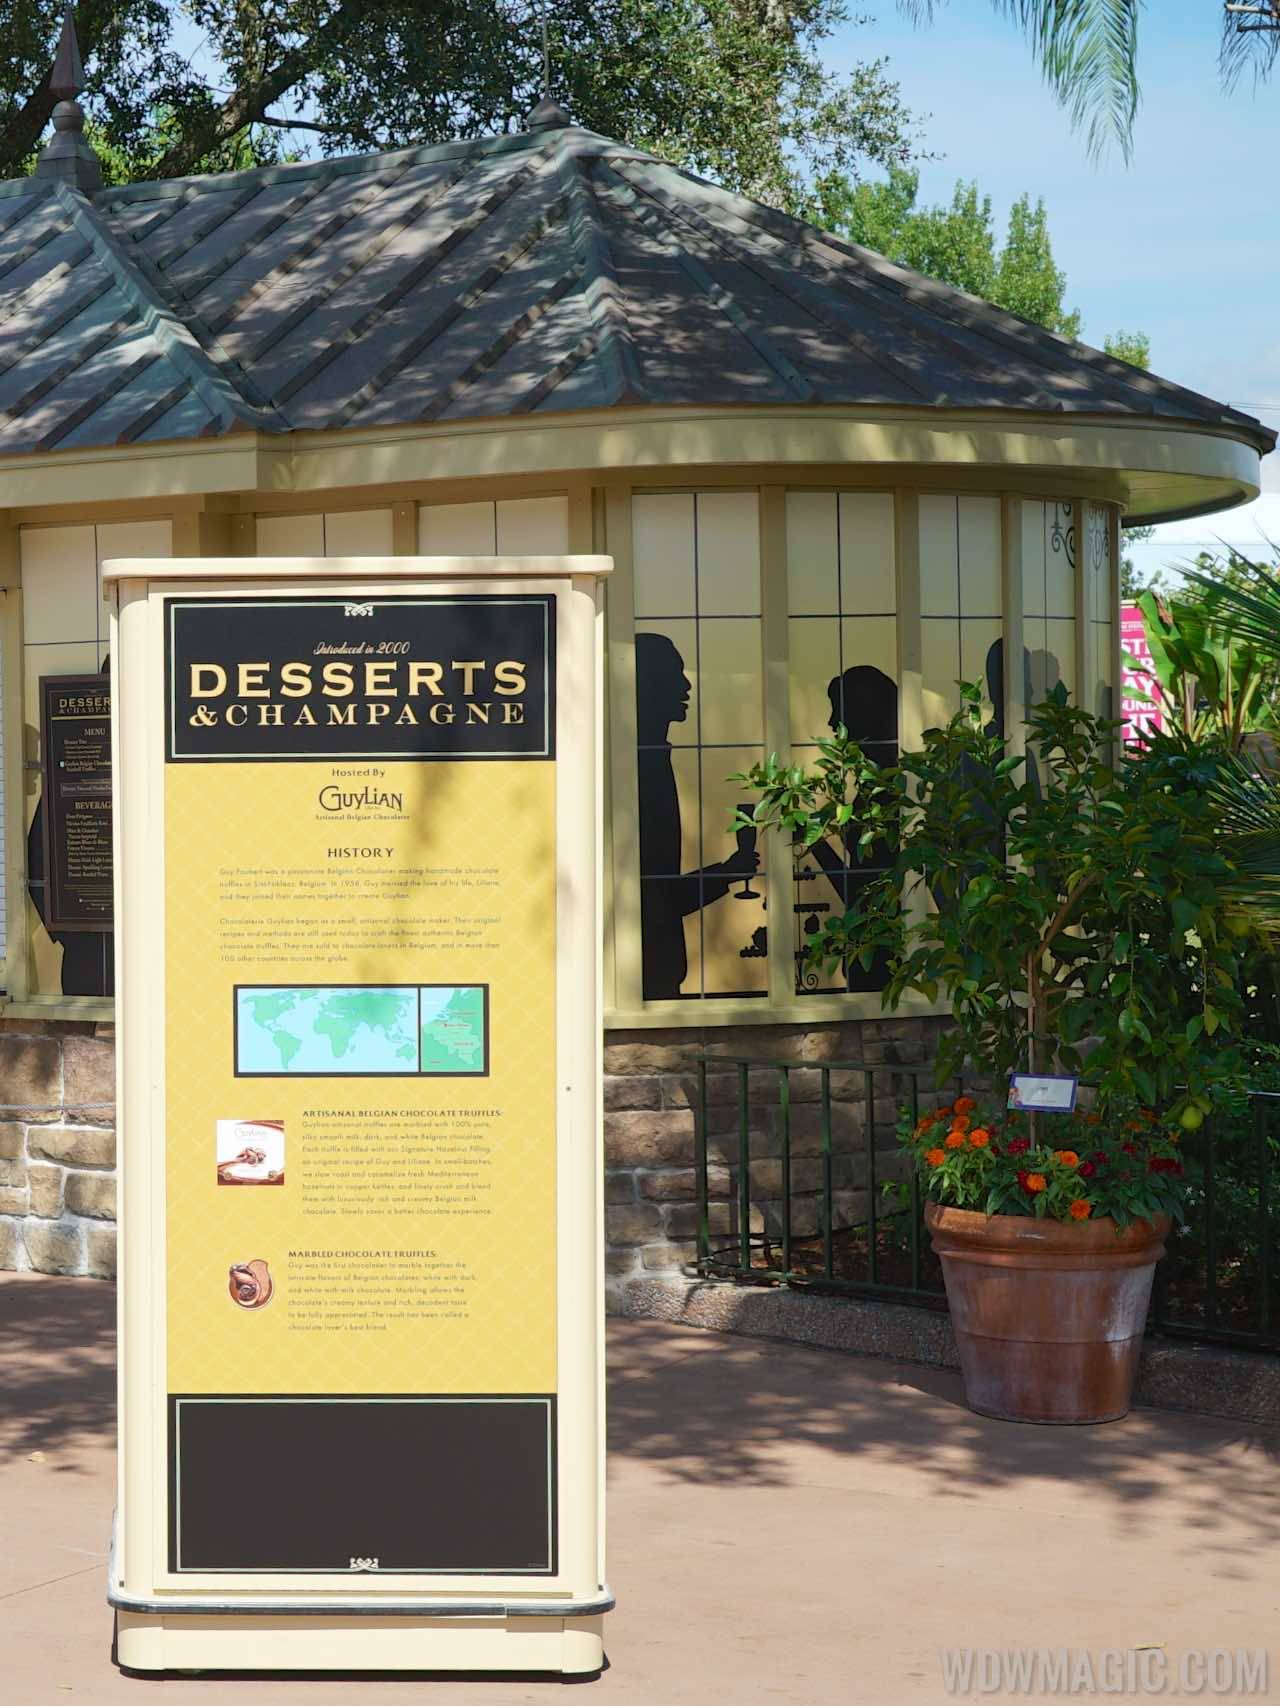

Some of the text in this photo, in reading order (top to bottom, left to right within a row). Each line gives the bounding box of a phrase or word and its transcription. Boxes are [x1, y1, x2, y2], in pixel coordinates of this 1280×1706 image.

[313, 641, 410, 655] Introduced in 2000
[189, 660, 528, 699] DESSERTS
[59, 697, 111, 708] DESSER
[84, 728, 106, 737] MENU
[332, 768, 385, 778] Hosted By
[75, 801, 113, 811] BEVERAG
[327, 847, 395, 858] HISTORY
[302, 1110, 356, 1118] ARTISANAL
[358, 1110, 398, 1118] BELGIAN
[400, 1109, 456, 1117] CHOCOLATE
